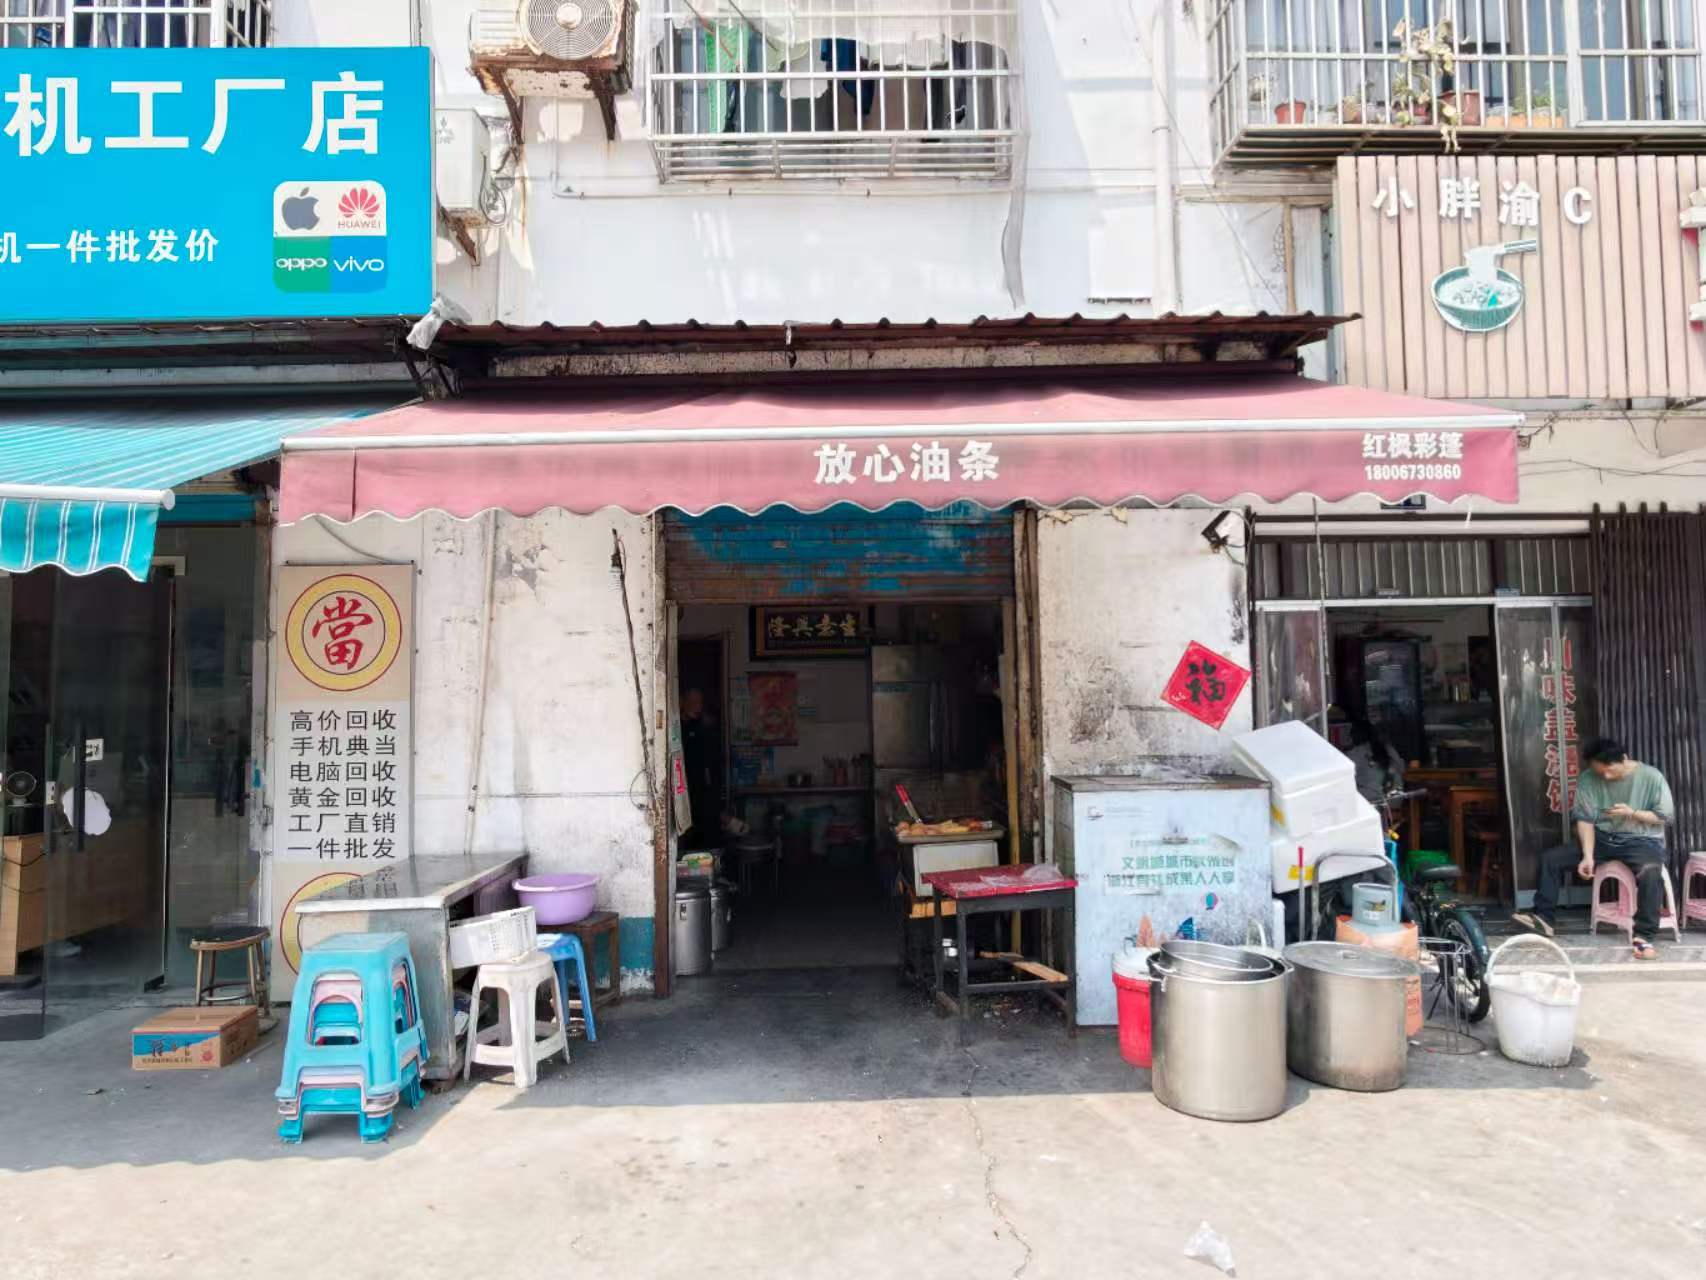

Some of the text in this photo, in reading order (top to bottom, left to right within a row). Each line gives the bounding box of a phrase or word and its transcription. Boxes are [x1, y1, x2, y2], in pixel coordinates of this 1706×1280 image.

[4, 71, 384, 156] 机工厂店
[1372, 177, 1592, 226] 小胖渝C
[337, 220, 381, 229] HUAWEI
[0, 228, 219, 263] 机一件批发价
[333, 255, 384, 272] vivo
[1362, 432, 1463, 459] 红枫彩篷
[813, 440, 999, 485] 放心油条
[1364, 464, 1461, 480] 18006730860
[311, 596, 373, 670] 當
[289, 709, 397, 731] 高价回收
[289, 735, 397, 757] 手机典当
[289, 760, 397, 783] 电脑回收
[288, 786, 397, 808] 黄金回收
[287, 812, 397, 834] 工厂直销
[287, 837, 397, 860] 一件批发
